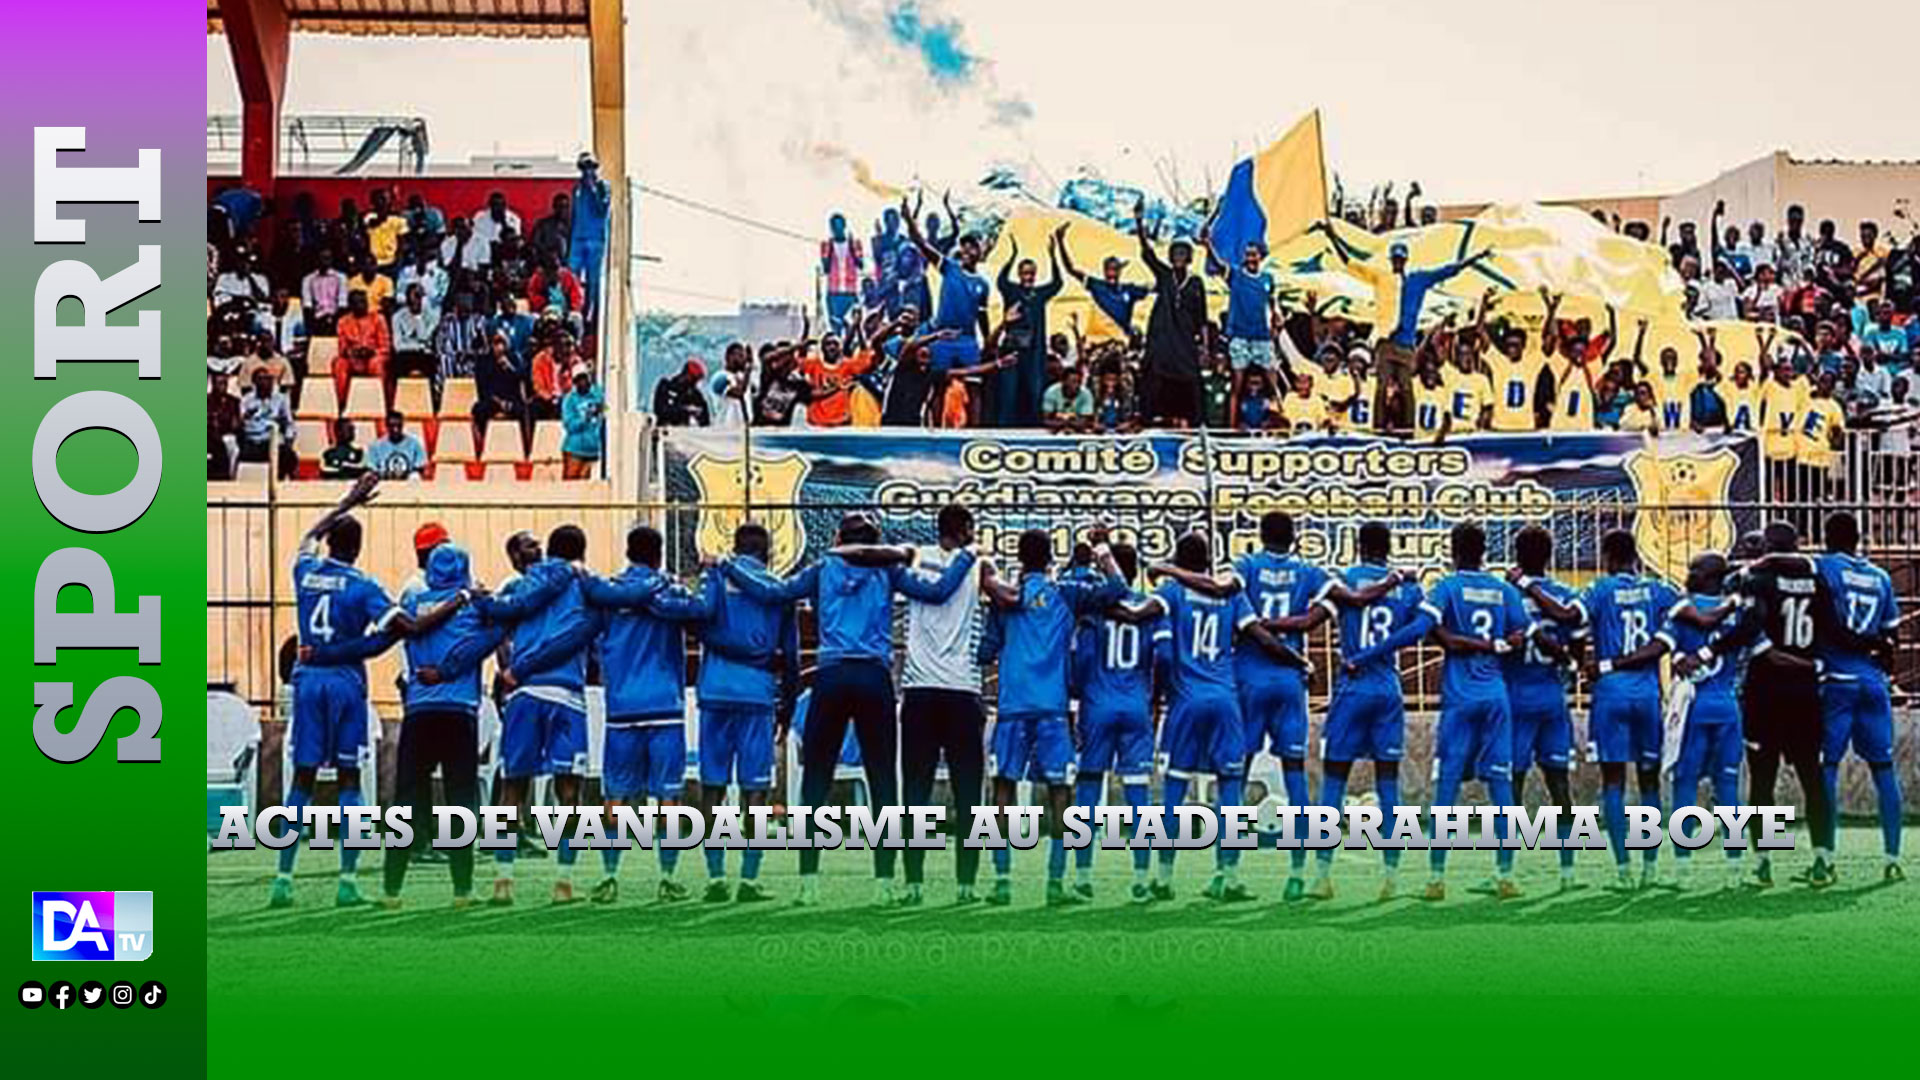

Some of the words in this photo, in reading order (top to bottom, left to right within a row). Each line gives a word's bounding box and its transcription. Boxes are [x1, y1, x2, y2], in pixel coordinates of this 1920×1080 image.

[965, 442, 1154, 474] Comité
[1185, 447, 1468, 480] Supporters
[880, 482, 1205, 516] Guédiawaye
[1216, 485, 1426, 515] Football
[1436, 484, 1552, 515] Club
[1231, 532, 1325, 559] ns
[1336, 527, 1456, 566] jur
[309, 593, 335, 643] 4
[1359, 604, 1393, 650] 13
[1620, 610, 1650, 655] 18
[1781, 596, 1814, 648] 16
[1846, 591, 1878, 635] 17
[1105, 619, 1139, 669] 10
[1191, 610, 1221, 662] 14
